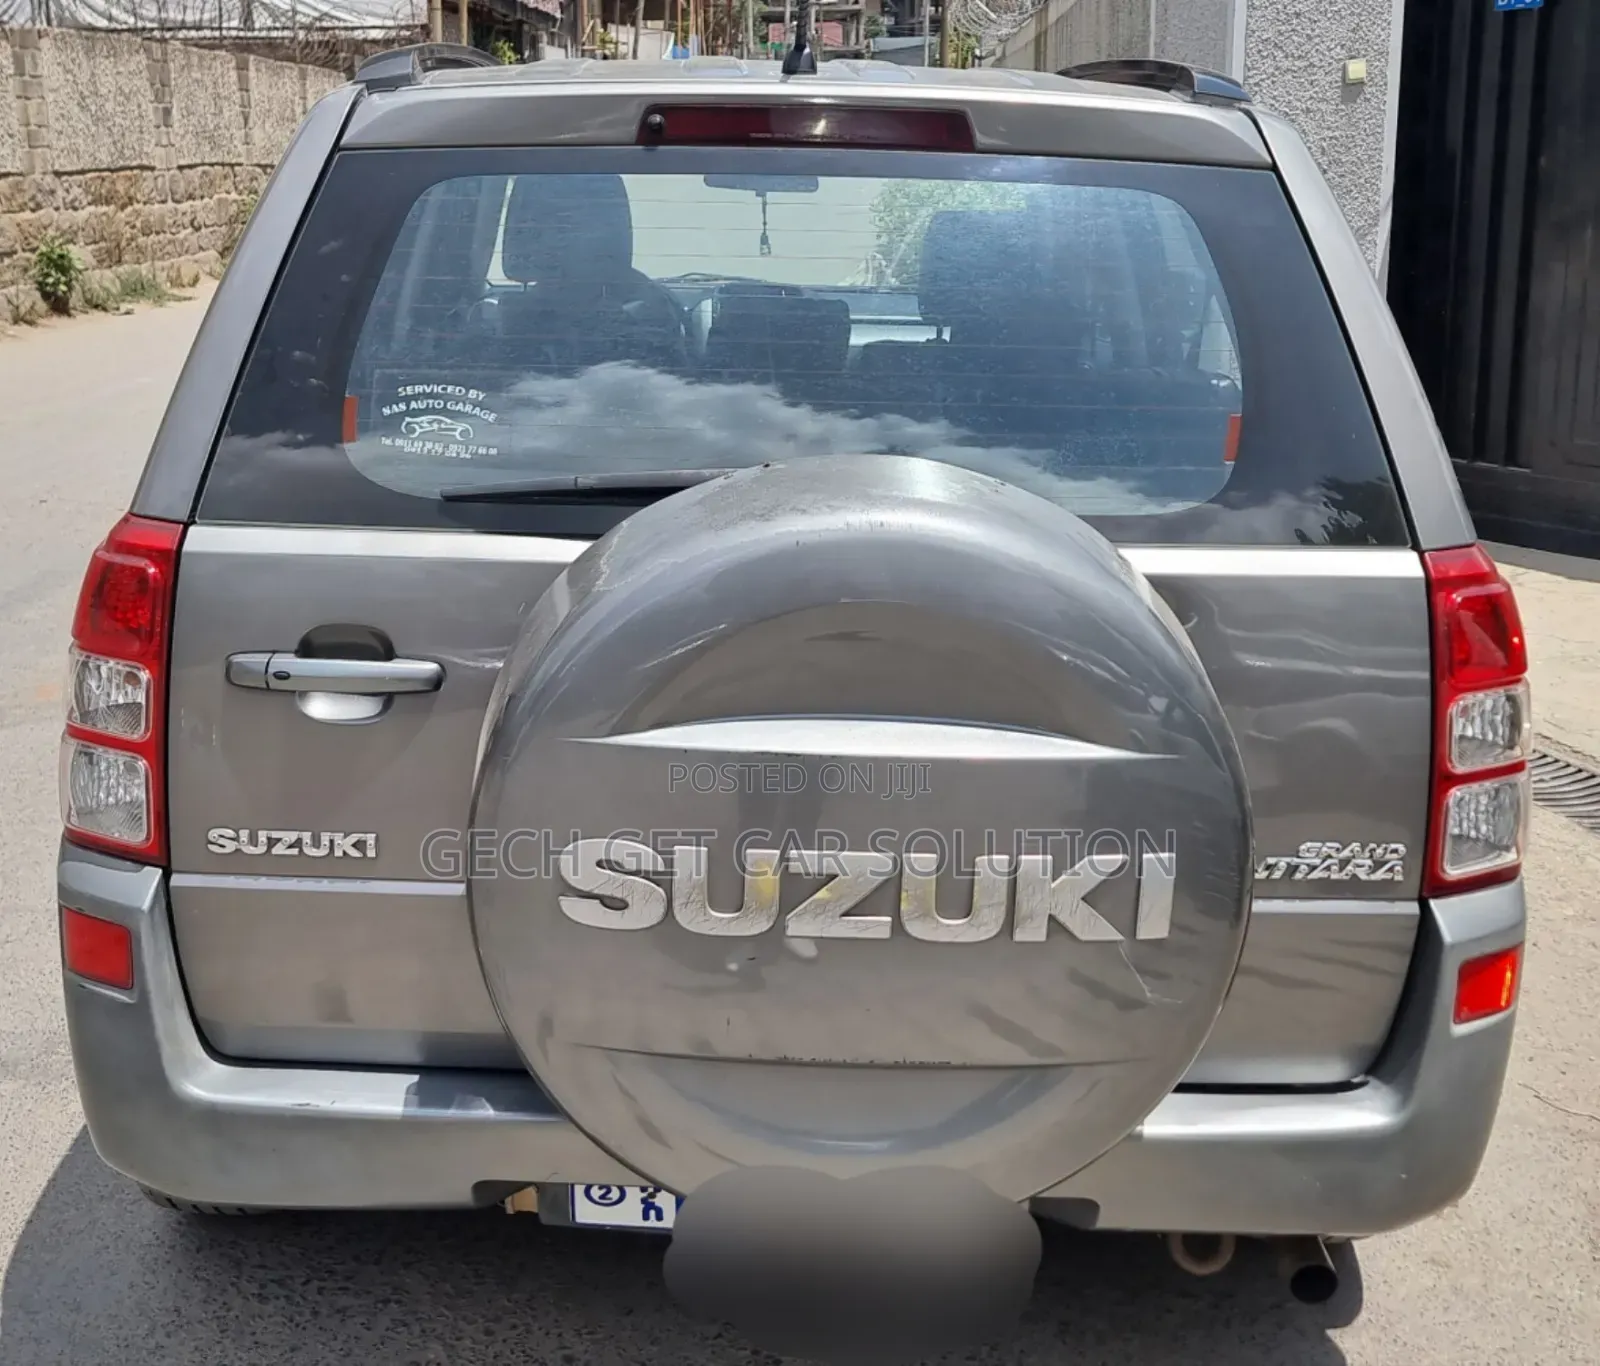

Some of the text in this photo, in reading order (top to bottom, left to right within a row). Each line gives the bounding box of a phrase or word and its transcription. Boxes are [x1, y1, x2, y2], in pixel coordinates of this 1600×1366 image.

[397, 384, 487, 401] SERVICED BY
[409, 399, 444, 410] AUTO
[446, 401, 499, 423] GARAGE
[207, 827, 378, 858] SUZUKI
[1298, 841, 1407, 859] GRAND
[558, 838, 1176, 942] SUZUKI
[597, 1184, 613, 1201] 2
